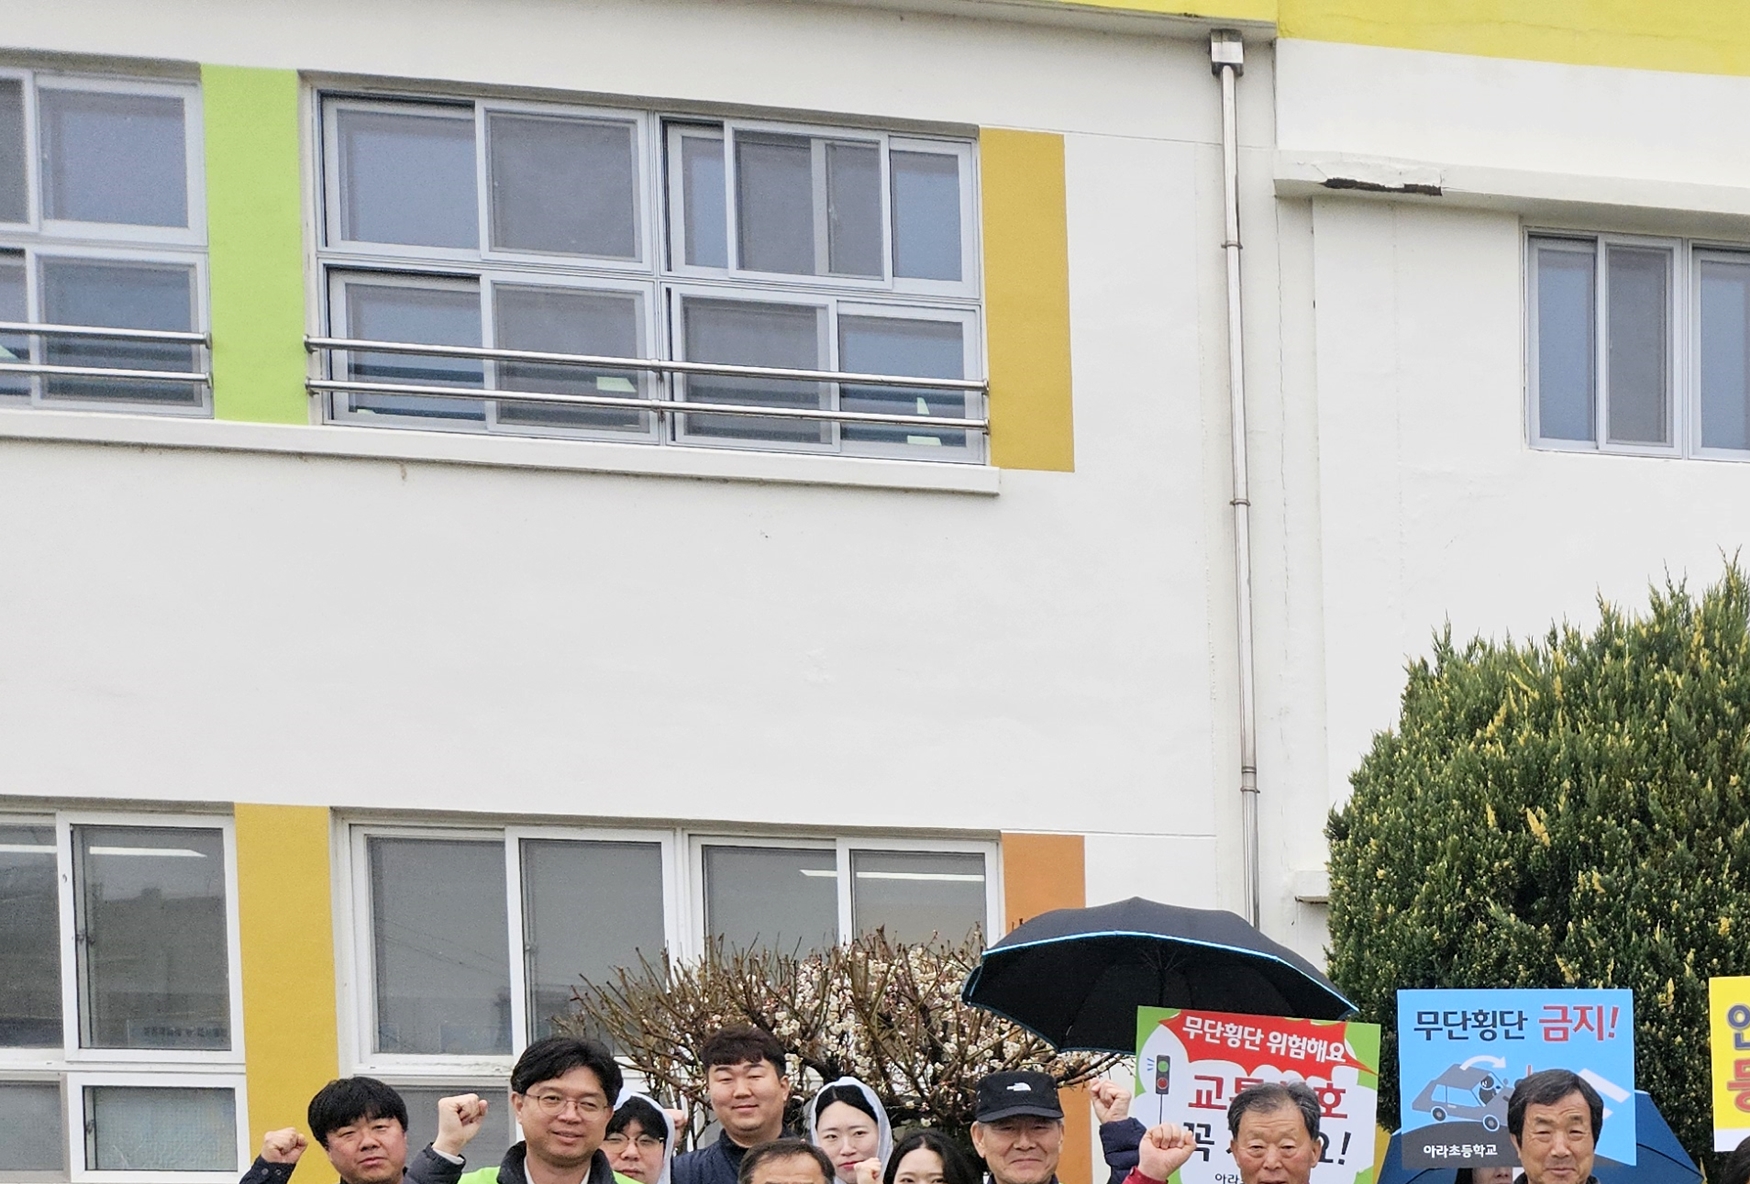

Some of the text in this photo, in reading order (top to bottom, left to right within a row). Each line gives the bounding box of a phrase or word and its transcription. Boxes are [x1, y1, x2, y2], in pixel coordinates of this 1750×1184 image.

[1182, 1015, 1347, 1063] 무단횡단 위험해요
[1414, 1005, 1620, 1043] 무단횡단 금지!
[1423, 1143, 1499, 1159] 아라초등학교
